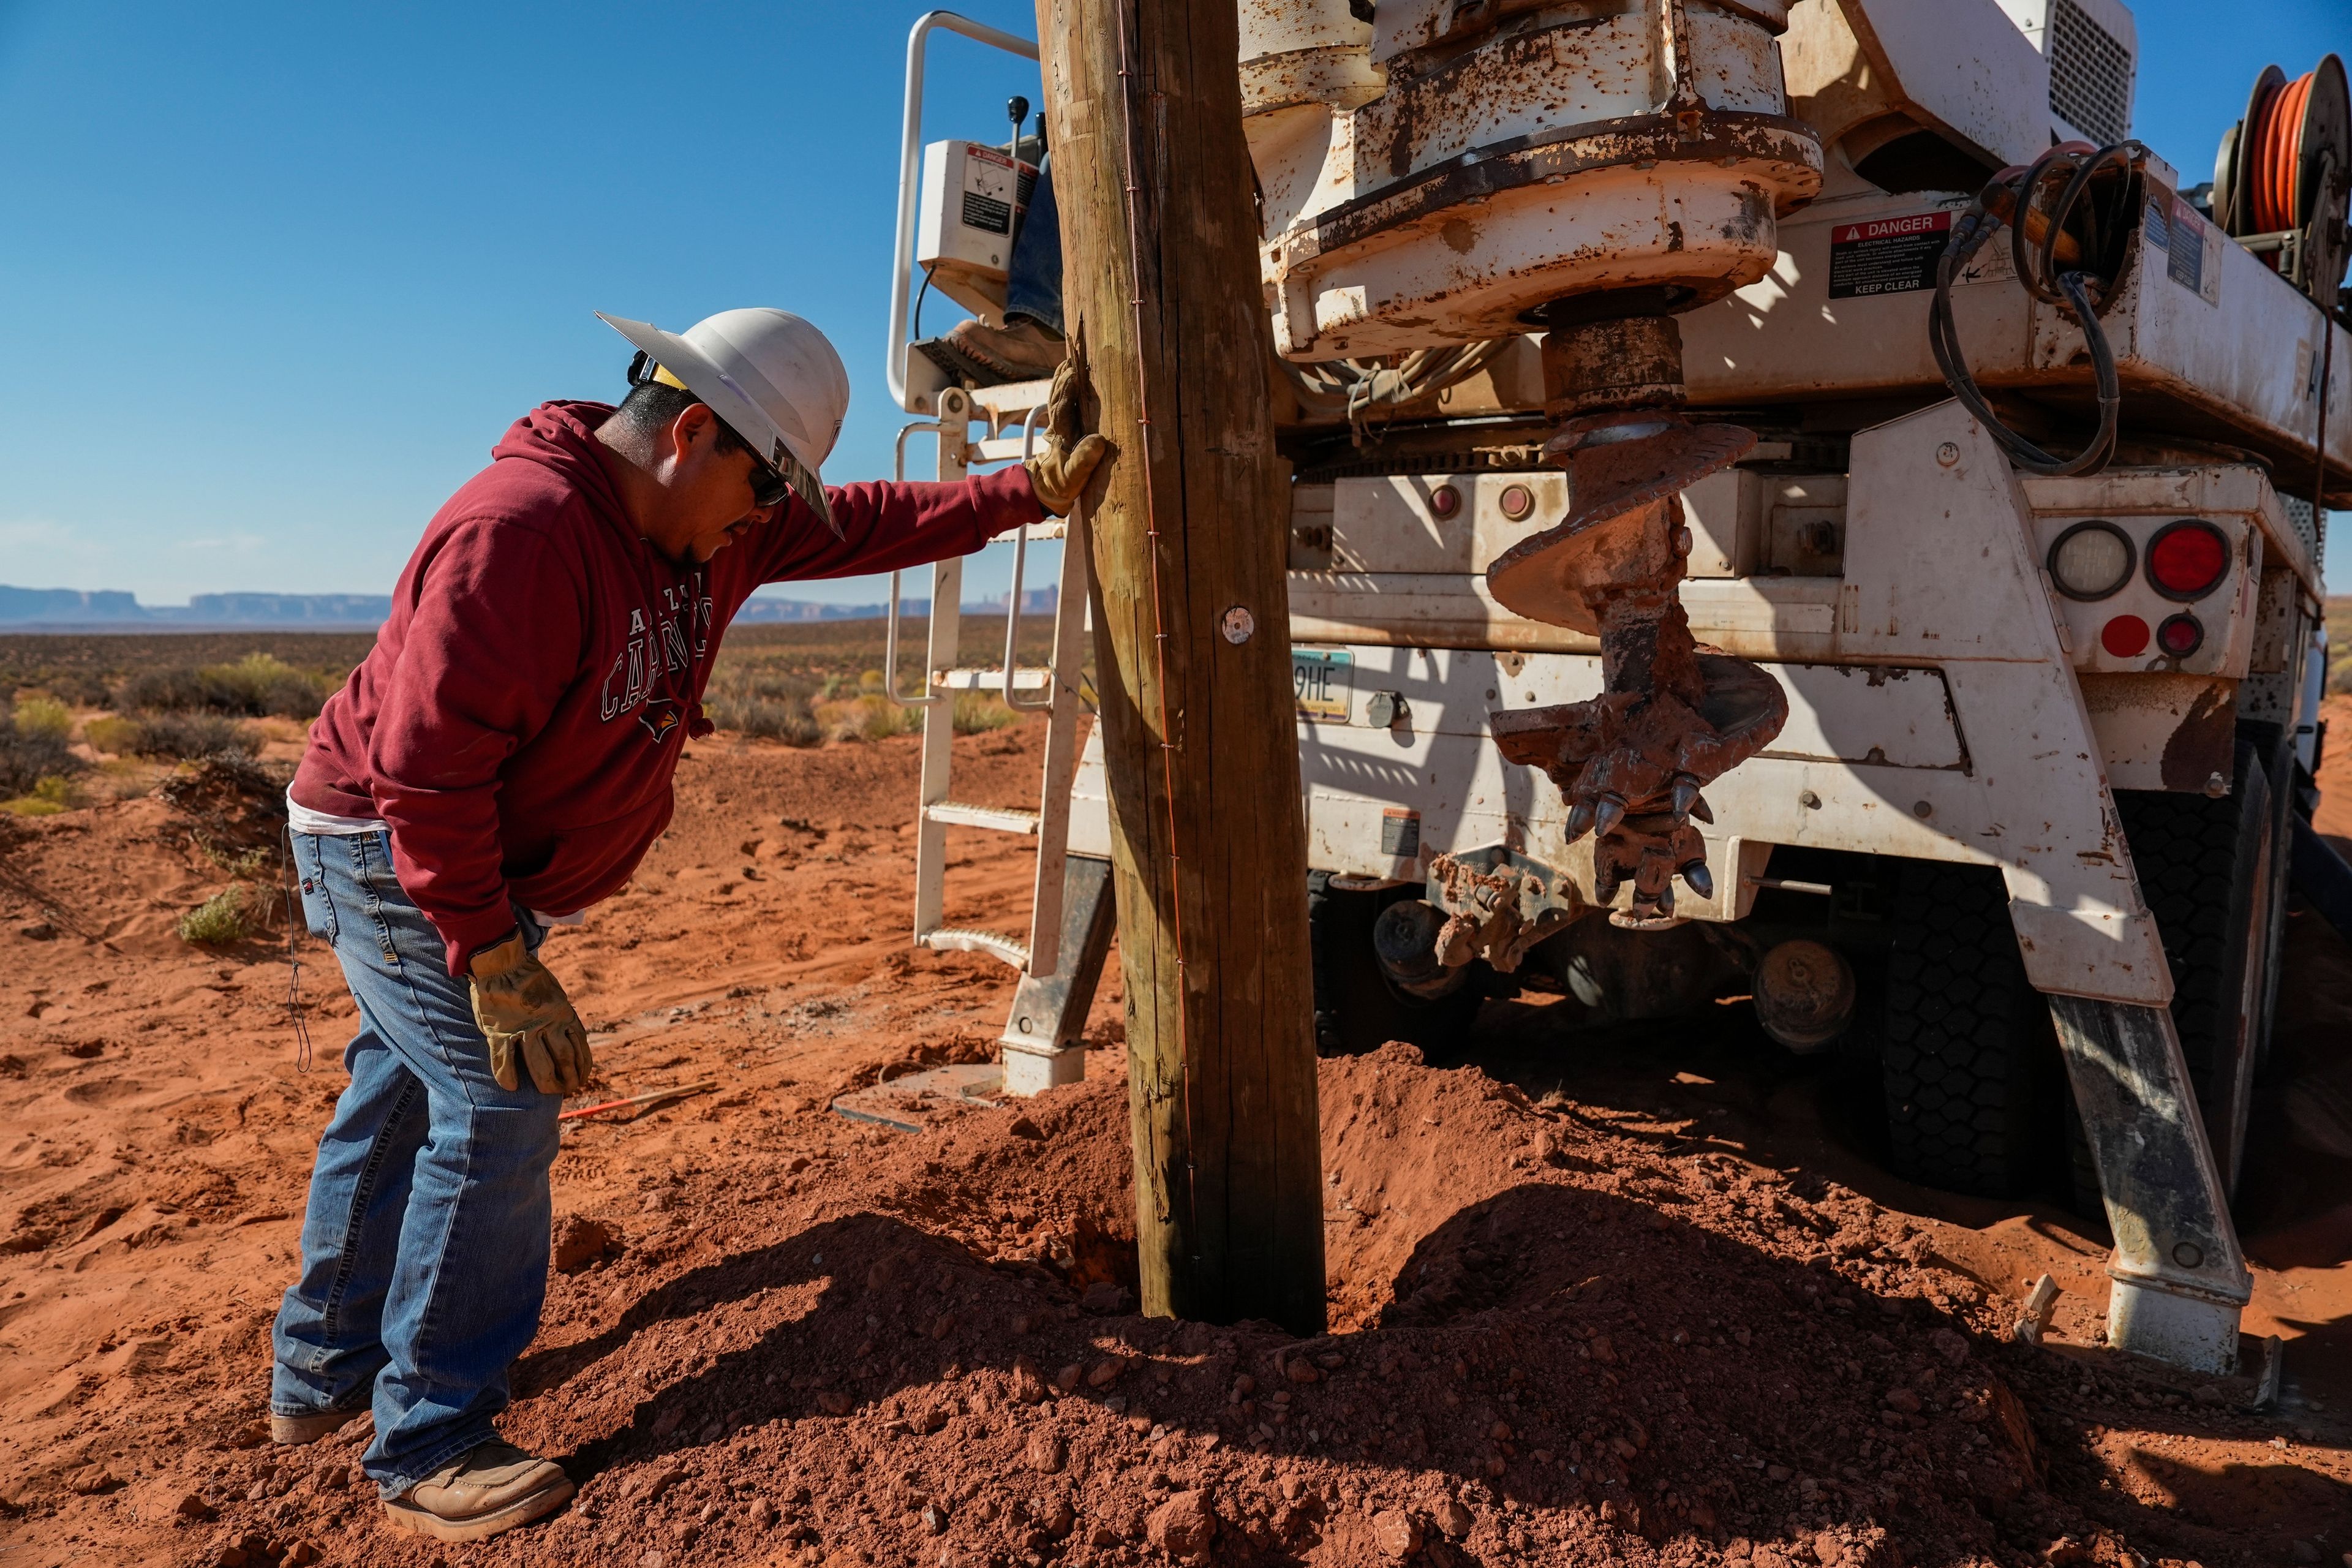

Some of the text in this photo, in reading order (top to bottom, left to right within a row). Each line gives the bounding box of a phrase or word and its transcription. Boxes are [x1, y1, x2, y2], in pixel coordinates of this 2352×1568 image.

[982, 151, 1008, 165] DANGER
[1868, 216, 1932, 236] DANGER
[2183, 206, 2201, 230] DANGER
[1858, 238, 1891, 247] ELECTRICAL
[1855, 279, 1919, 294] KEEP CLEAR
[1295, 666, 1335, 701] 9HE
